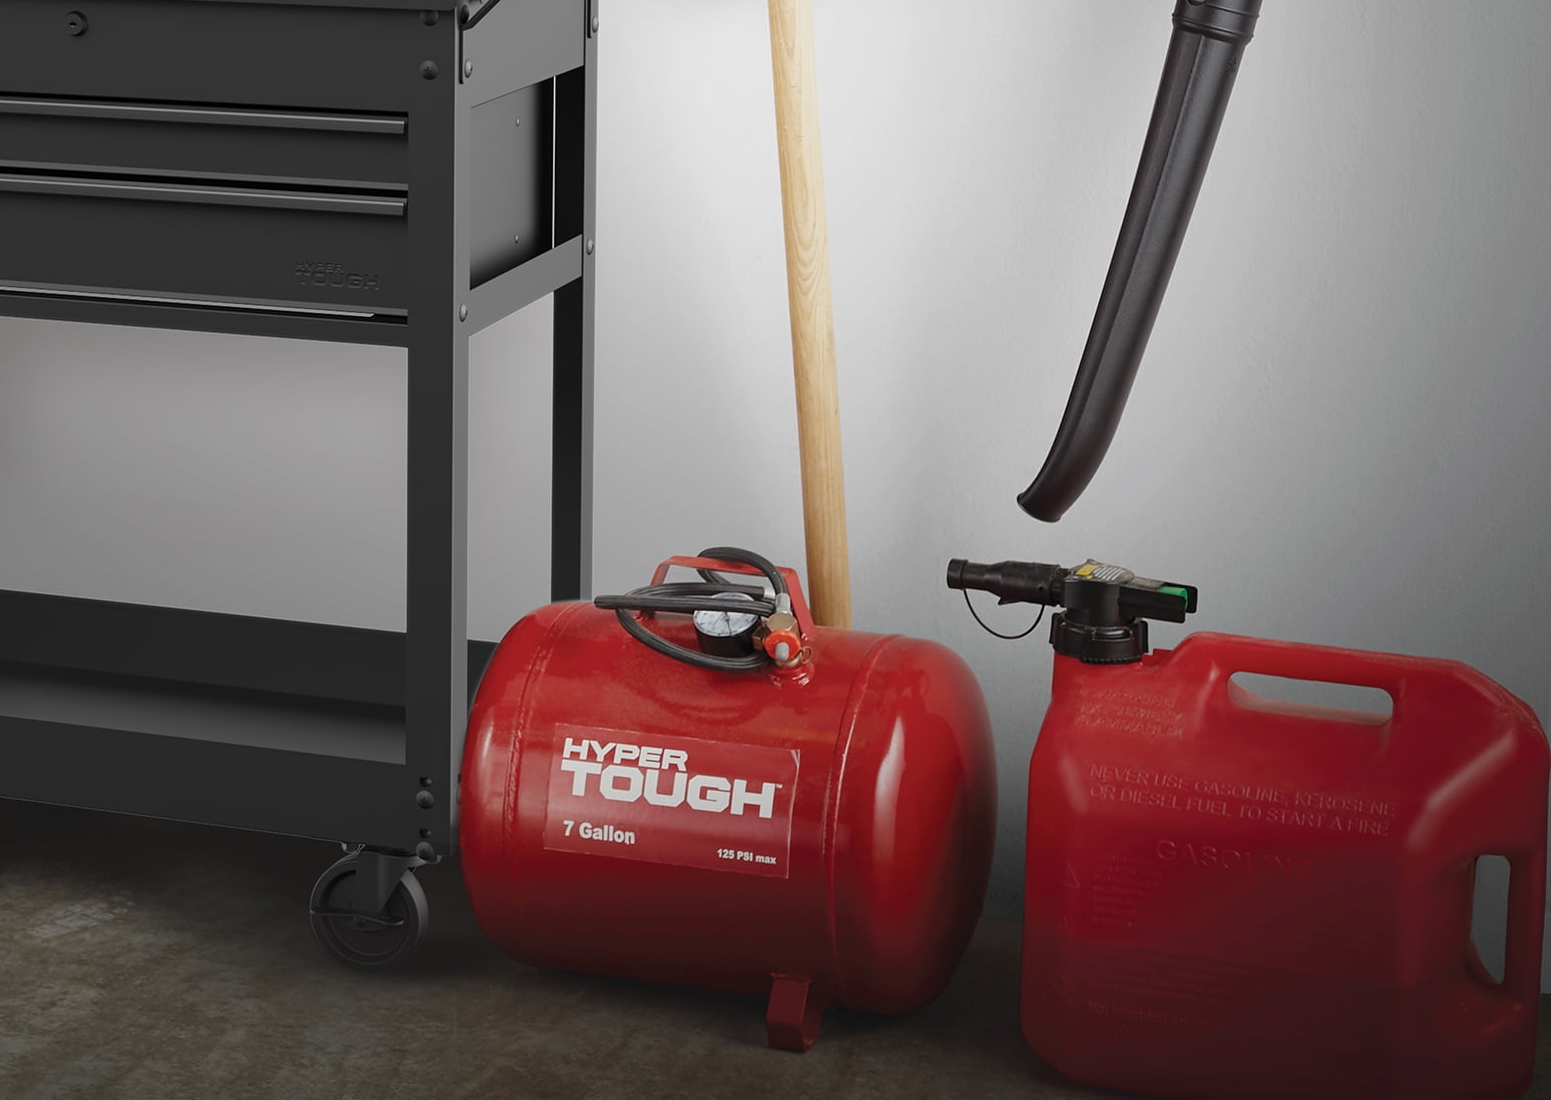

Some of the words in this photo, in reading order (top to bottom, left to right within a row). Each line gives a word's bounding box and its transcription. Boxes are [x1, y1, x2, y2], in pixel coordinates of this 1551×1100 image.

[562, 737, 689, 772] HYPER
[1090, 763, 1150, 787] NEVER
[1154, 773, 1190, 791] USE
[1194, 779, 1289, 806] GASOLINE,
[1294, 791, 1396, 819] KEROSENE
[1090, 785, 1117, 801] OR
[1119, 787, 1181, 811] DIESEL
[1186, 797, 1233, 818] FUEL
[1238, 804, 1263, 821] TO
[1266, 807, 1324, 829] START
[1329, 816, 1344, 833] A
[1346, 818, 1390, 837] FIRE
[562, 820, 575, 837] 7
[578, 822, 636, 845] Gallon
[716, 848, 735, 860] 125
[736, 850, 753, 861] PSI
[755, 853, 777, 865] max
[1155, 838, 1315, 883] GASOLINE
